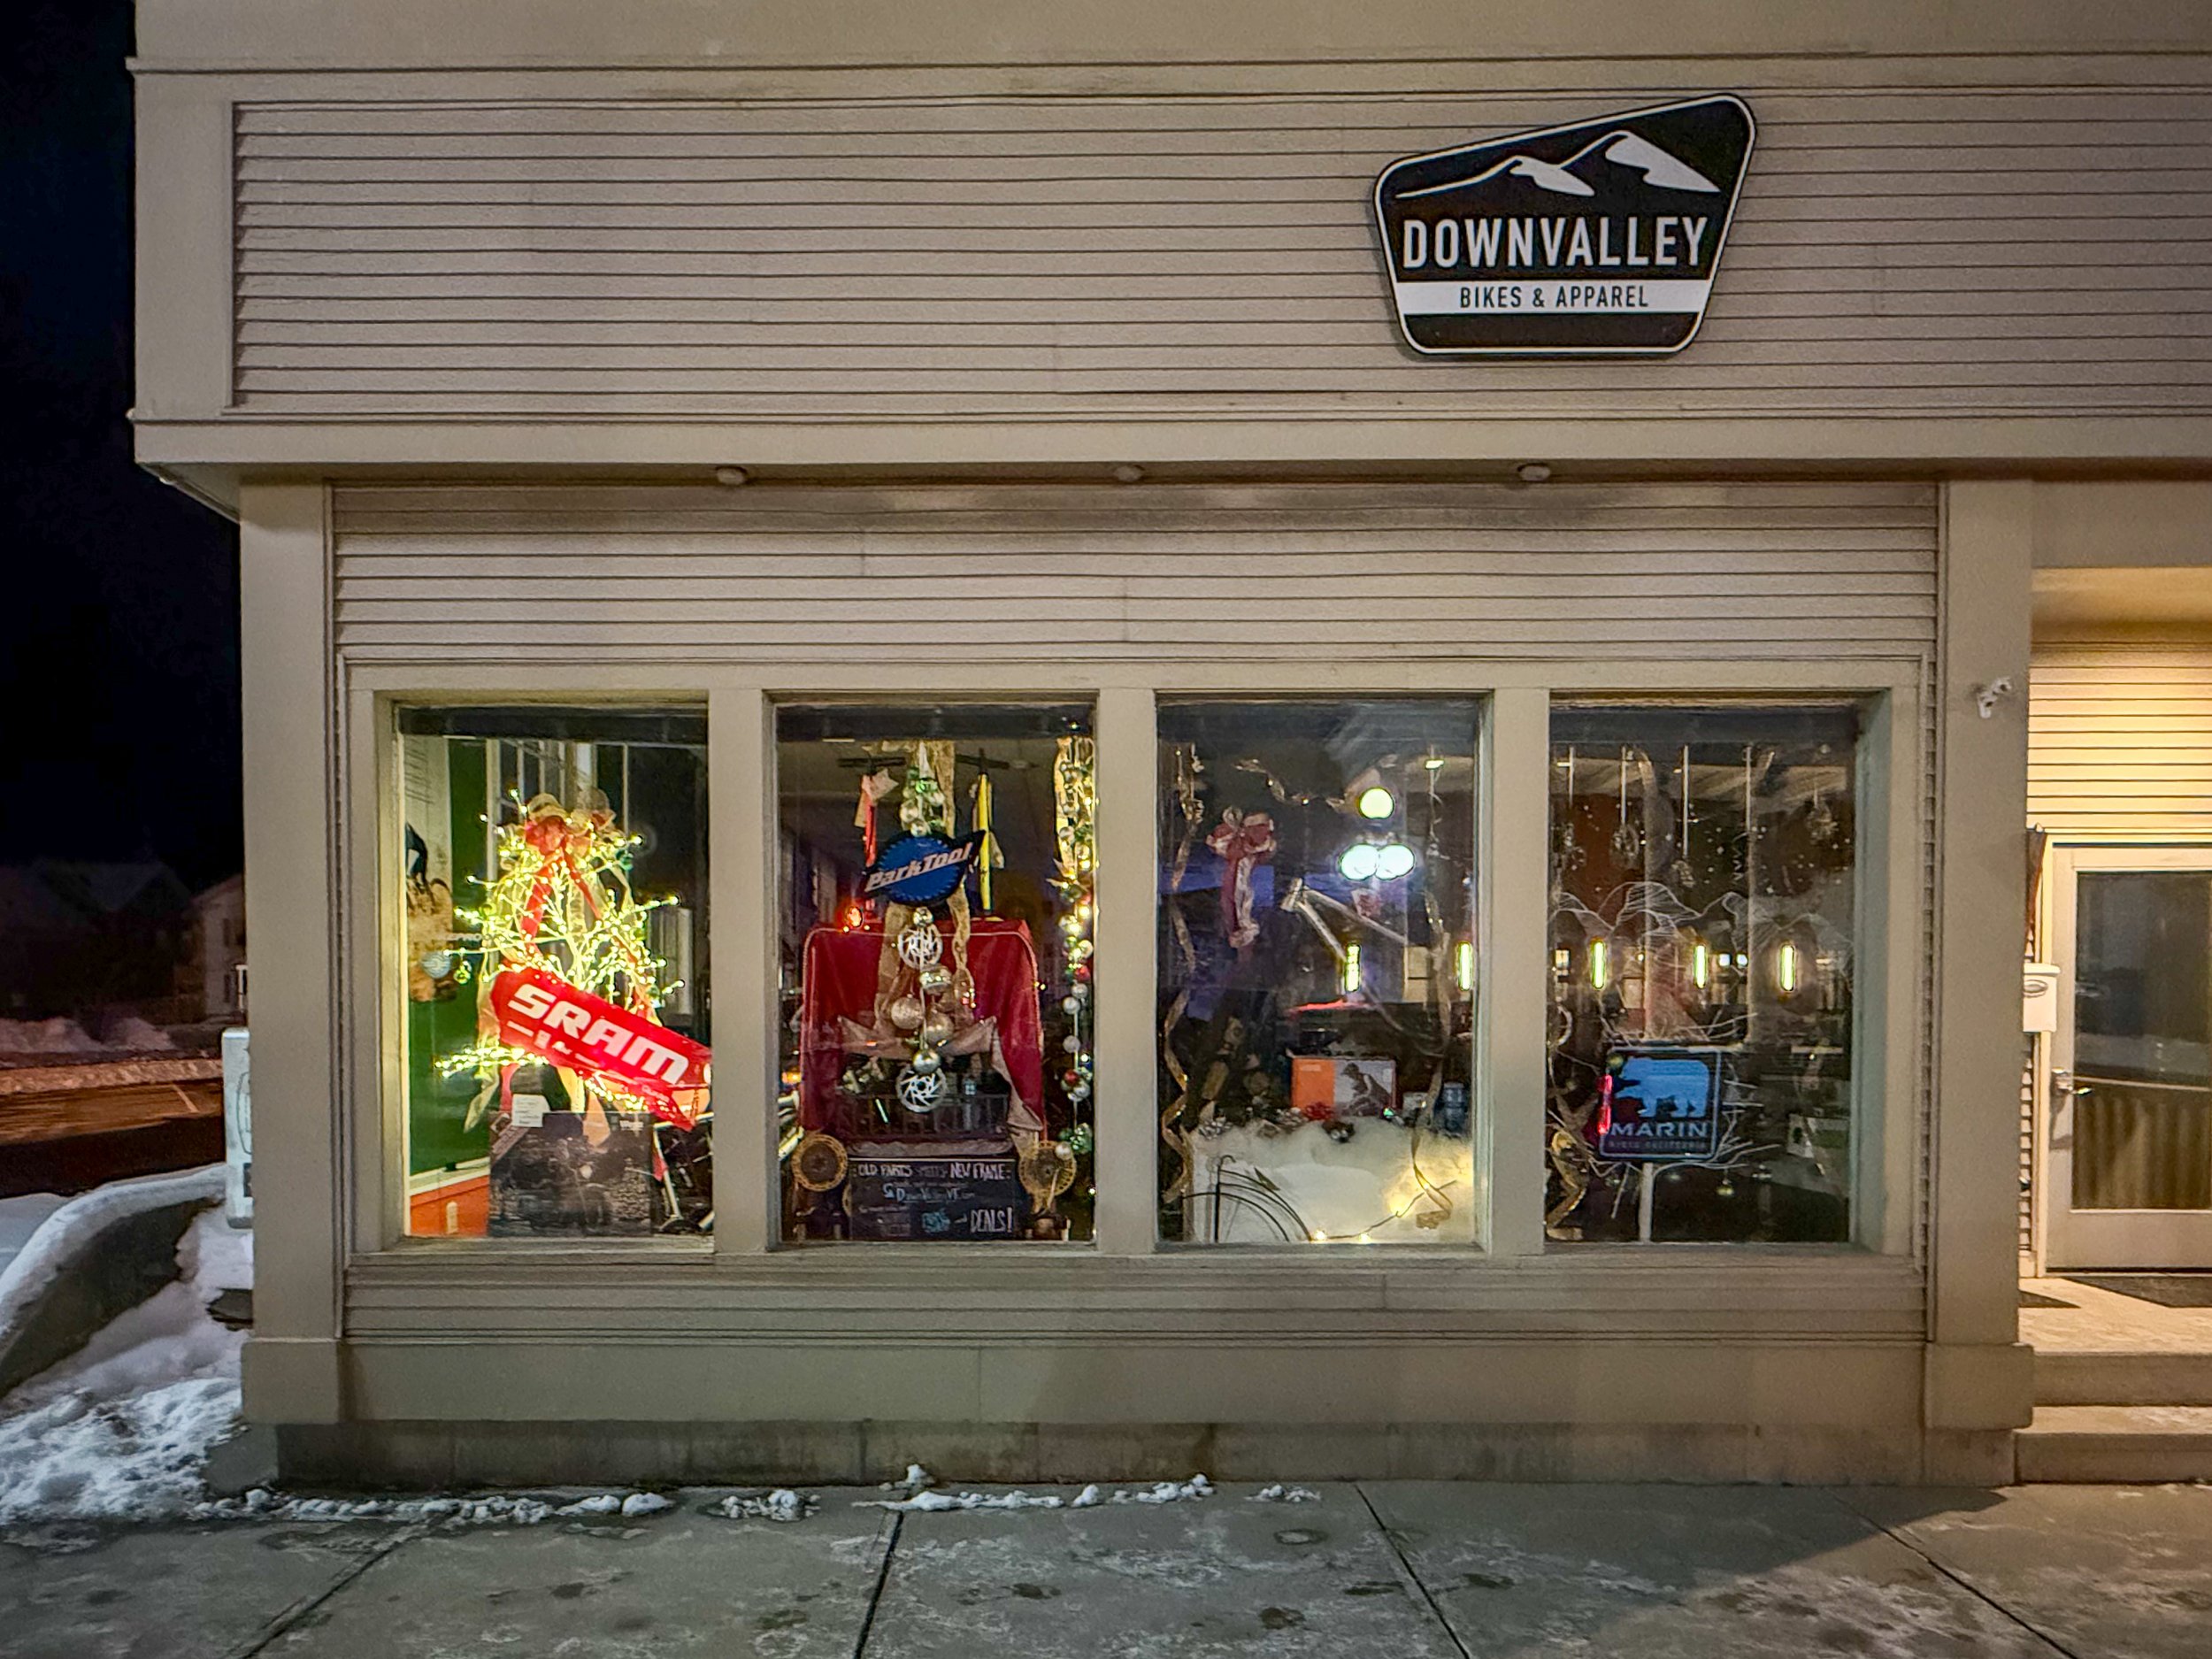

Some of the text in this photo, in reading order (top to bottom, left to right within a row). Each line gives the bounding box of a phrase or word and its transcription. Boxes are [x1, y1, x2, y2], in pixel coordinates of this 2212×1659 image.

[1402, 216, 1709, 269] DOWNVALLEY
[1459, 285, 1649, 309] BIKES & APPAREL
[507, 983, 690, 1086] SRAM
[1611, 1122, 1709, 1138] MARIN
